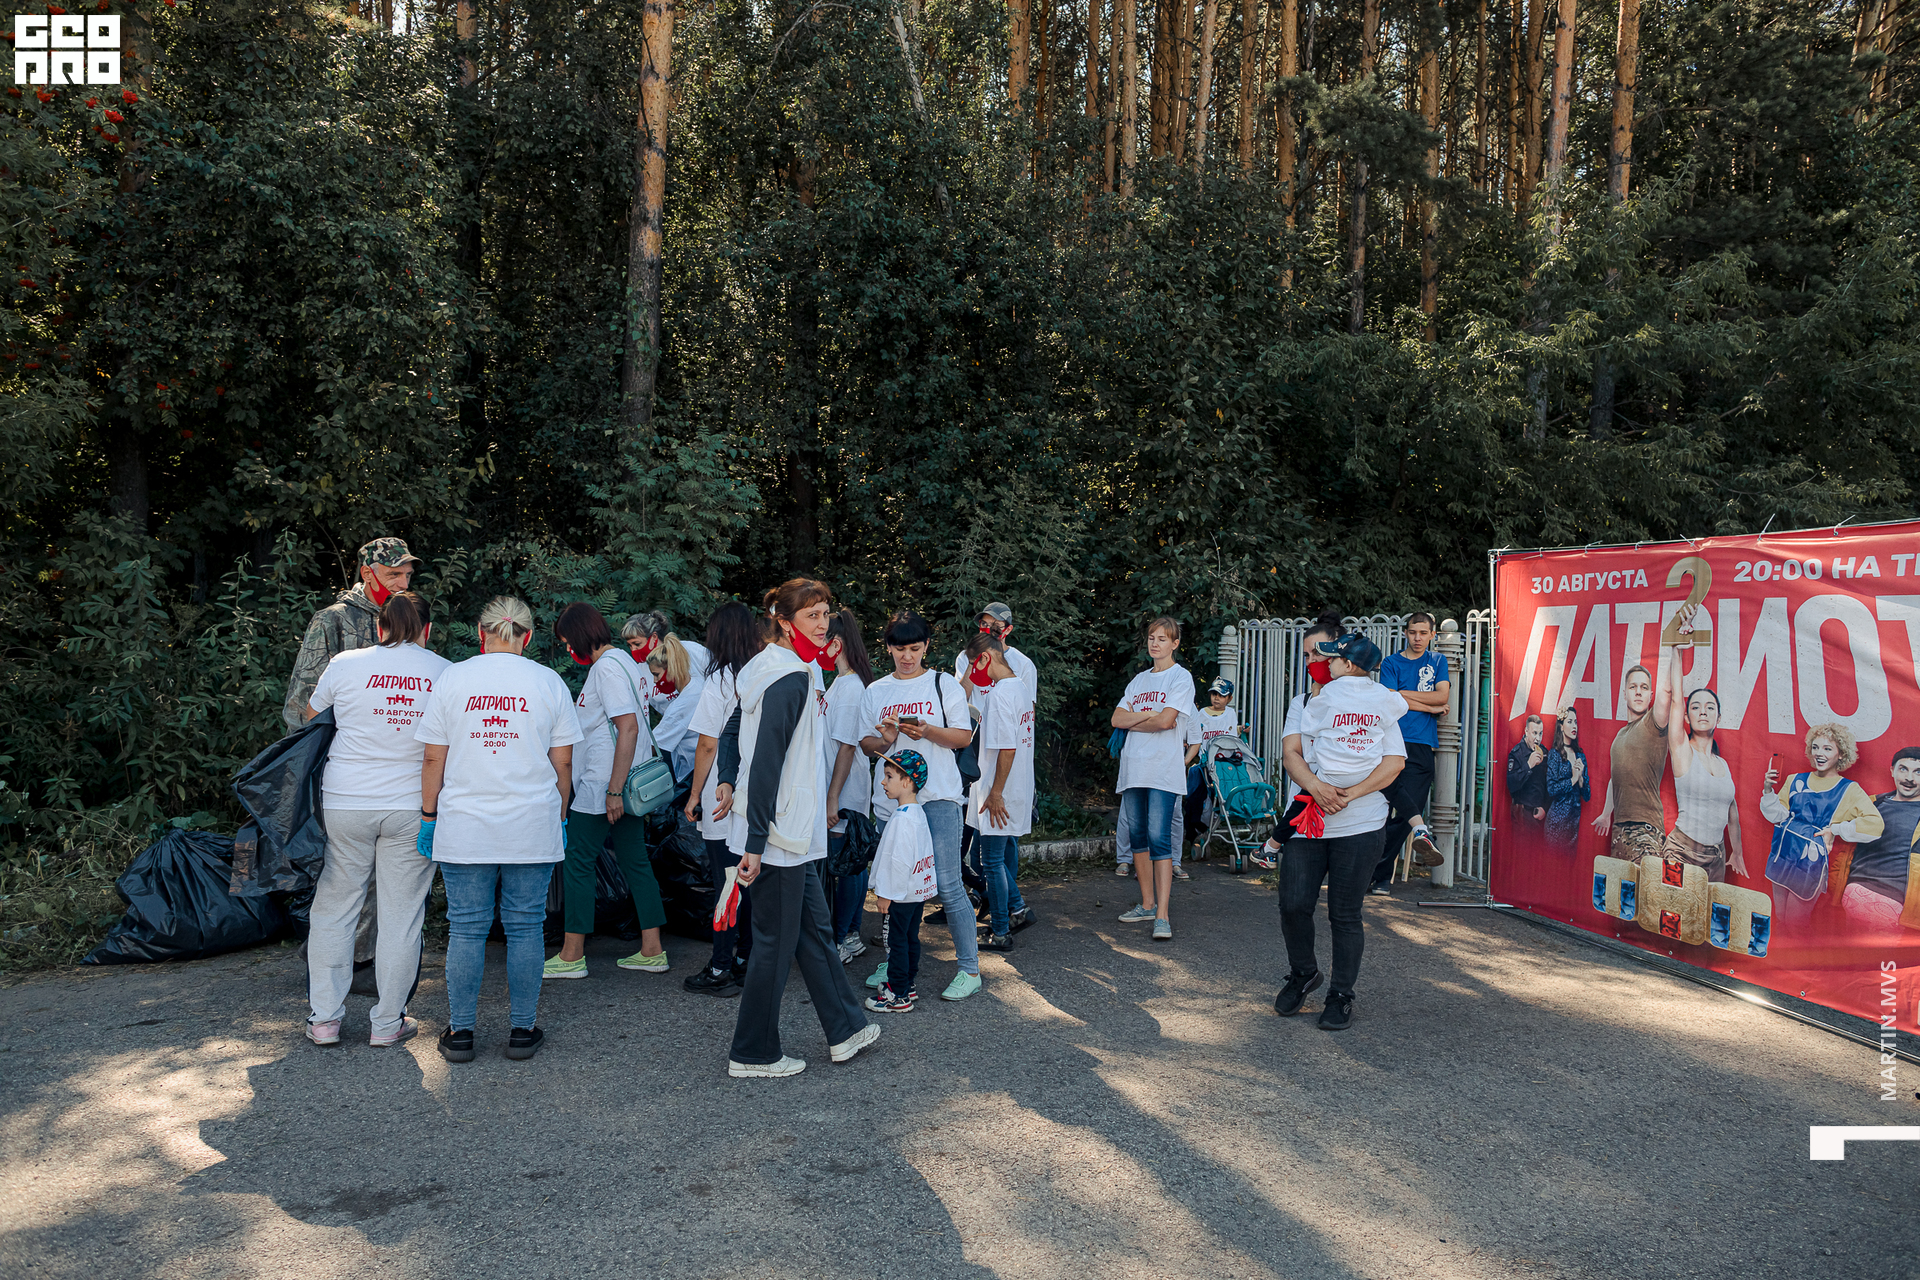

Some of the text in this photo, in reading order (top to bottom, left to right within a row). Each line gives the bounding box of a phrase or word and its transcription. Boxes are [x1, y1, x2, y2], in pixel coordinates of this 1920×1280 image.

[1531, 553, 1920, 594] 30 АВГУСТА 20:00 НА Т
[365, 674, 433, 693] ПАТРИОТ 2
[386, 694, 415, 706] ТНТ
[464, 695, 529, 713] ПАТРИОТ 2
[578, 692, 586, 708] 2
[1160, 691, 1167, 704] 2
[926, 701, 935, 716] 2
[387, 717, 412, 725] 20:00
[482, 715, 509, 728] ТНТ
[1332, 713, 1375, 729] ПАТРИОТ
[470, 731, 481, 739] 30
[483, 740, 507, 748] 20:00
[1592, 854, 1773, 959] ТНТ
